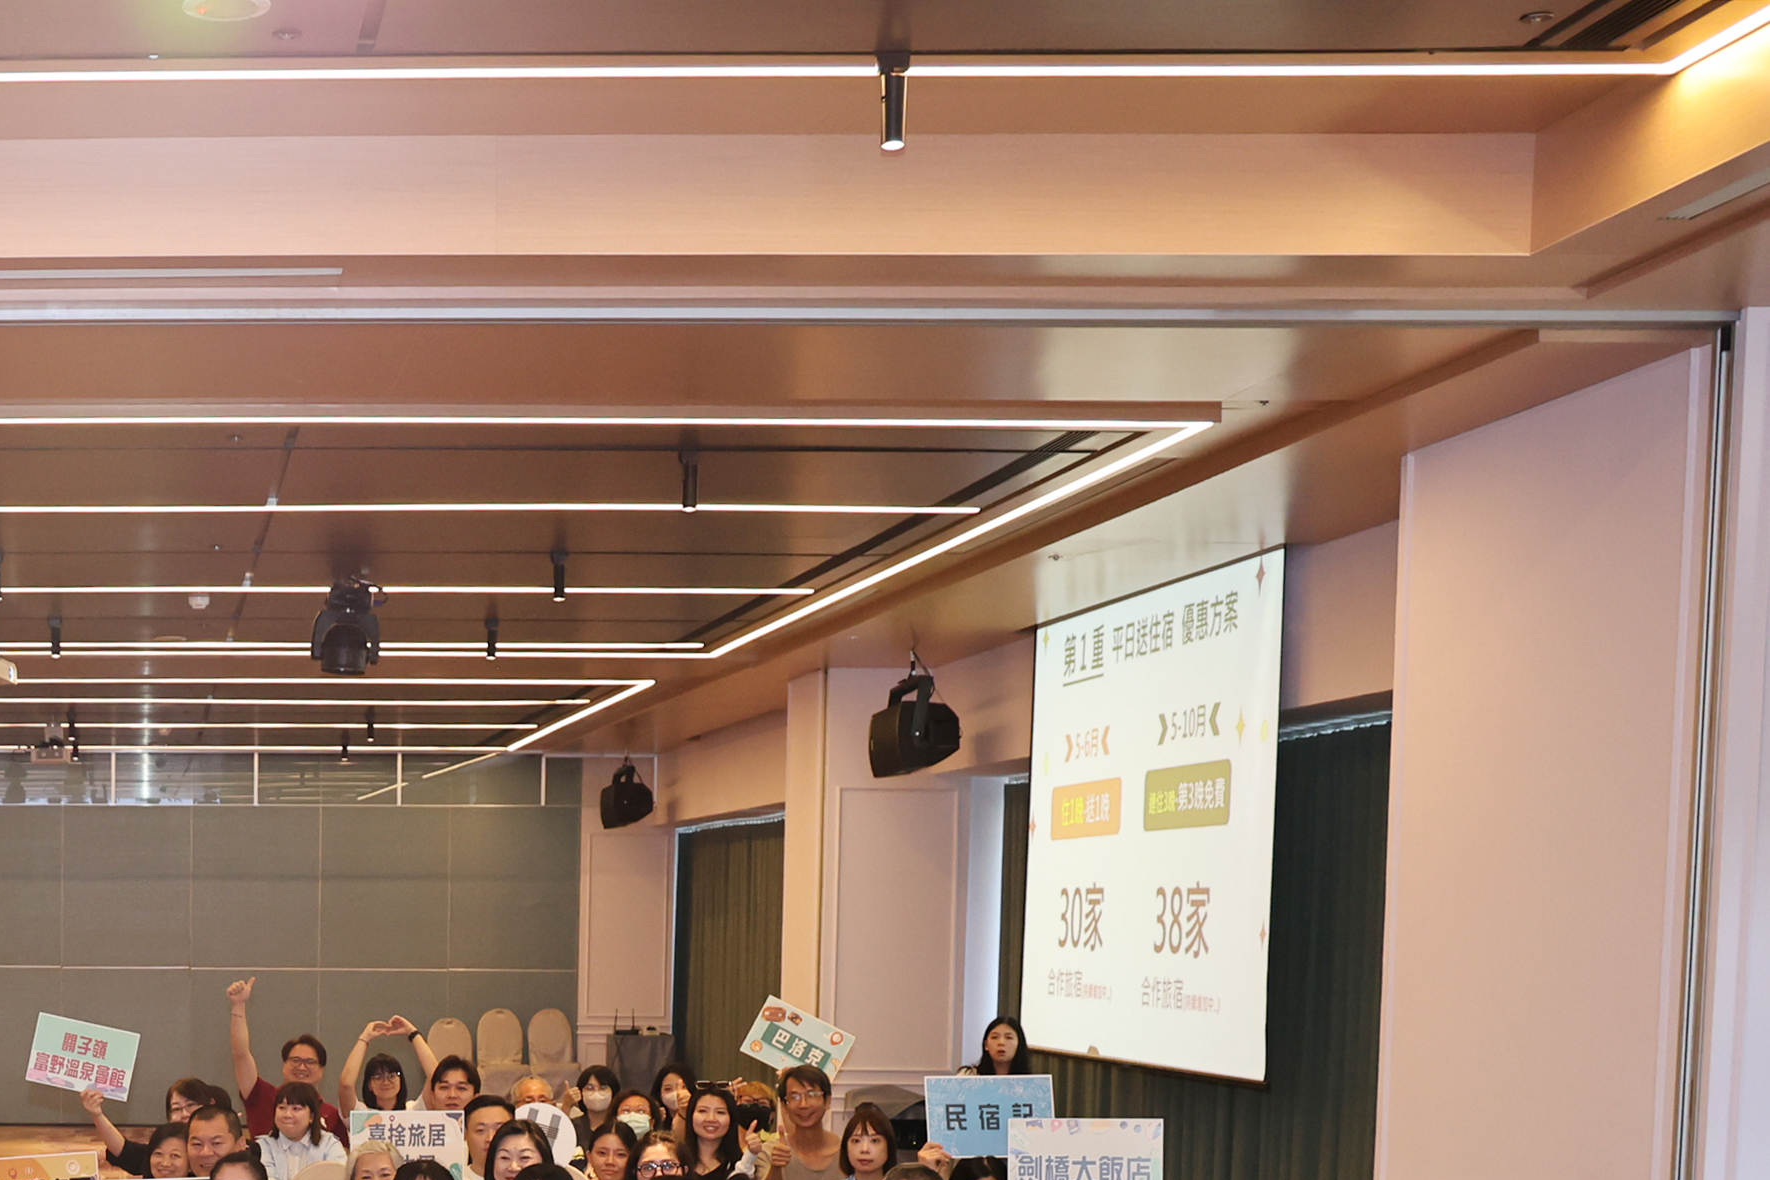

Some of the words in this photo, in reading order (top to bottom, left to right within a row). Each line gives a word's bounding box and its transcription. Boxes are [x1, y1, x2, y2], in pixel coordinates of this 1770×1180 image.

[1112, 610, 1175, 664] 平日送住宿
[1181, 590, 1239, 646] 優惠方案
[1170, 704, 1206, 741] 5-10月
[1075, 727, 1099, 760] 5-6月
[1058, 881, 1105, 953] 30家
[1153, 880, 1211, 960] 38家
[771, 1028, 825, 1067] 巴洛克
[33, 1052, 127, 1088] 富野溫泉會館
